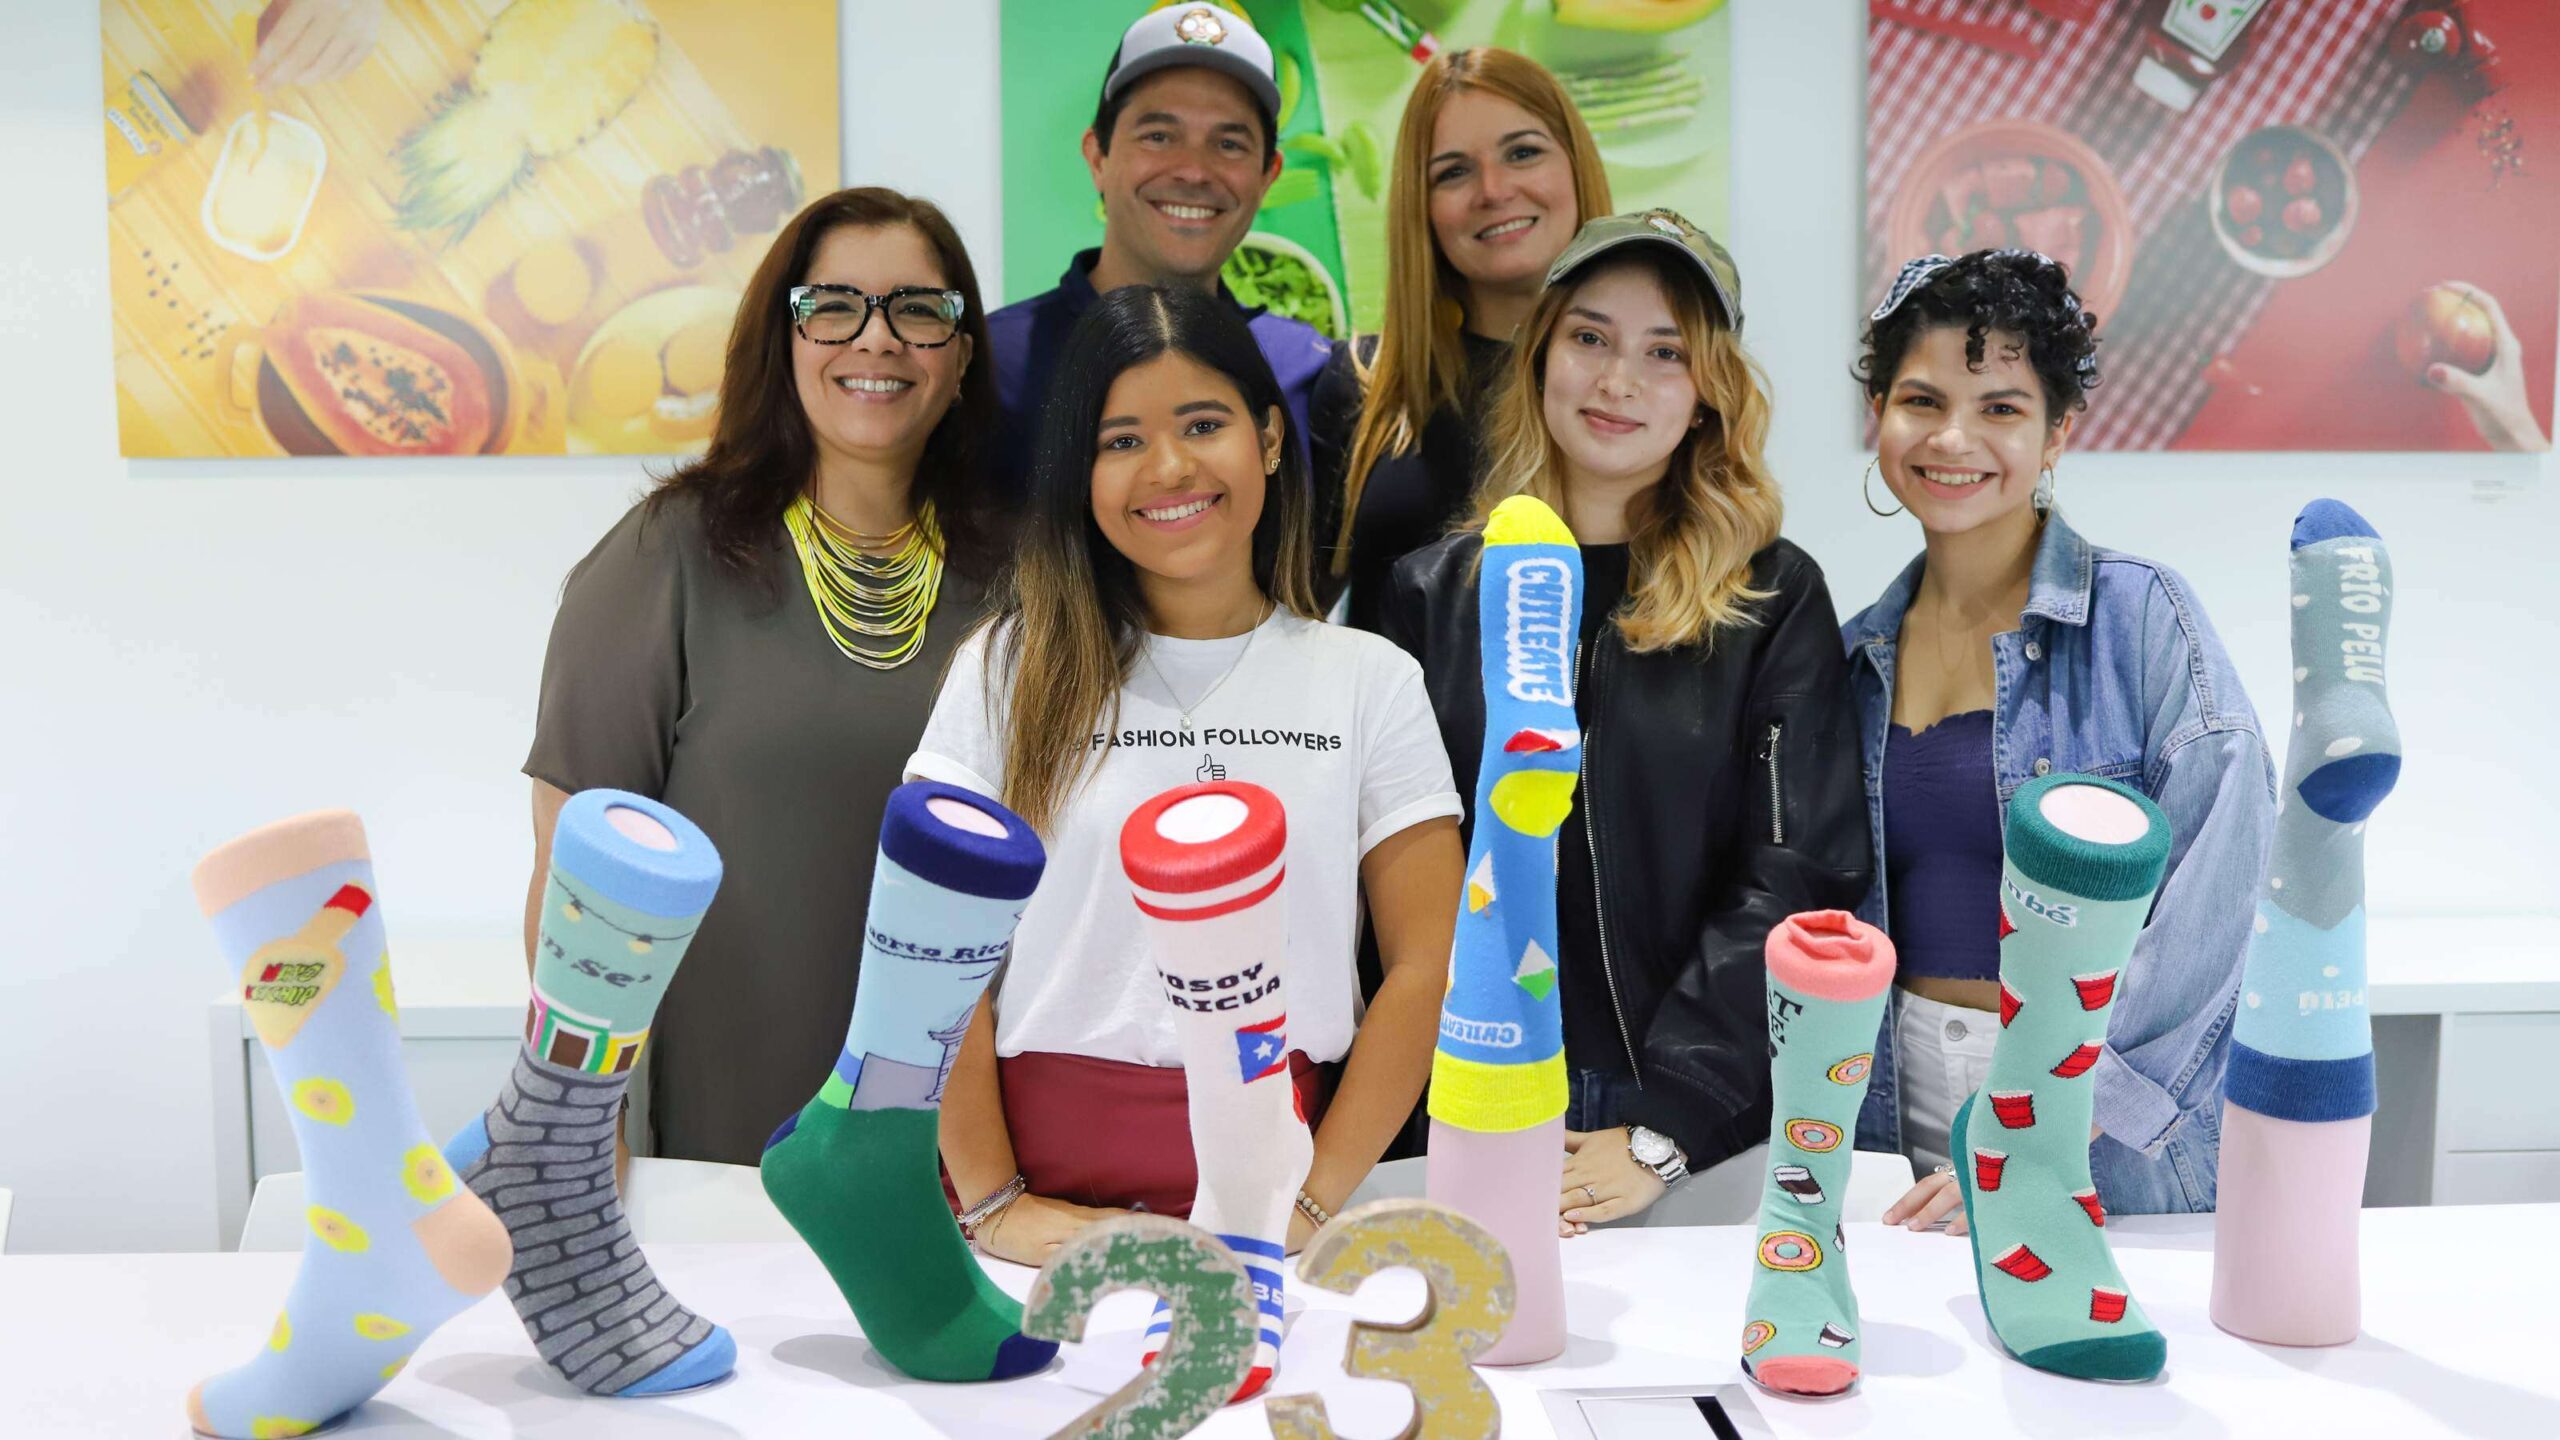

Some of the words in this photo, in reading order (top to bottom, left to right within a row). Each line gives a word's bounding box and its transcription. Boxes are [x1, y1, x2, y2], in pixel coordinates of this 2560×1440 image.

[1508, 559, 1571, 705] CHILEATE
[1091, 729, 1196, 751] FASHION
[1204, 728, 1343, 751] FOLLOWERS
[1156, 962, 1264, 993] OSOY
